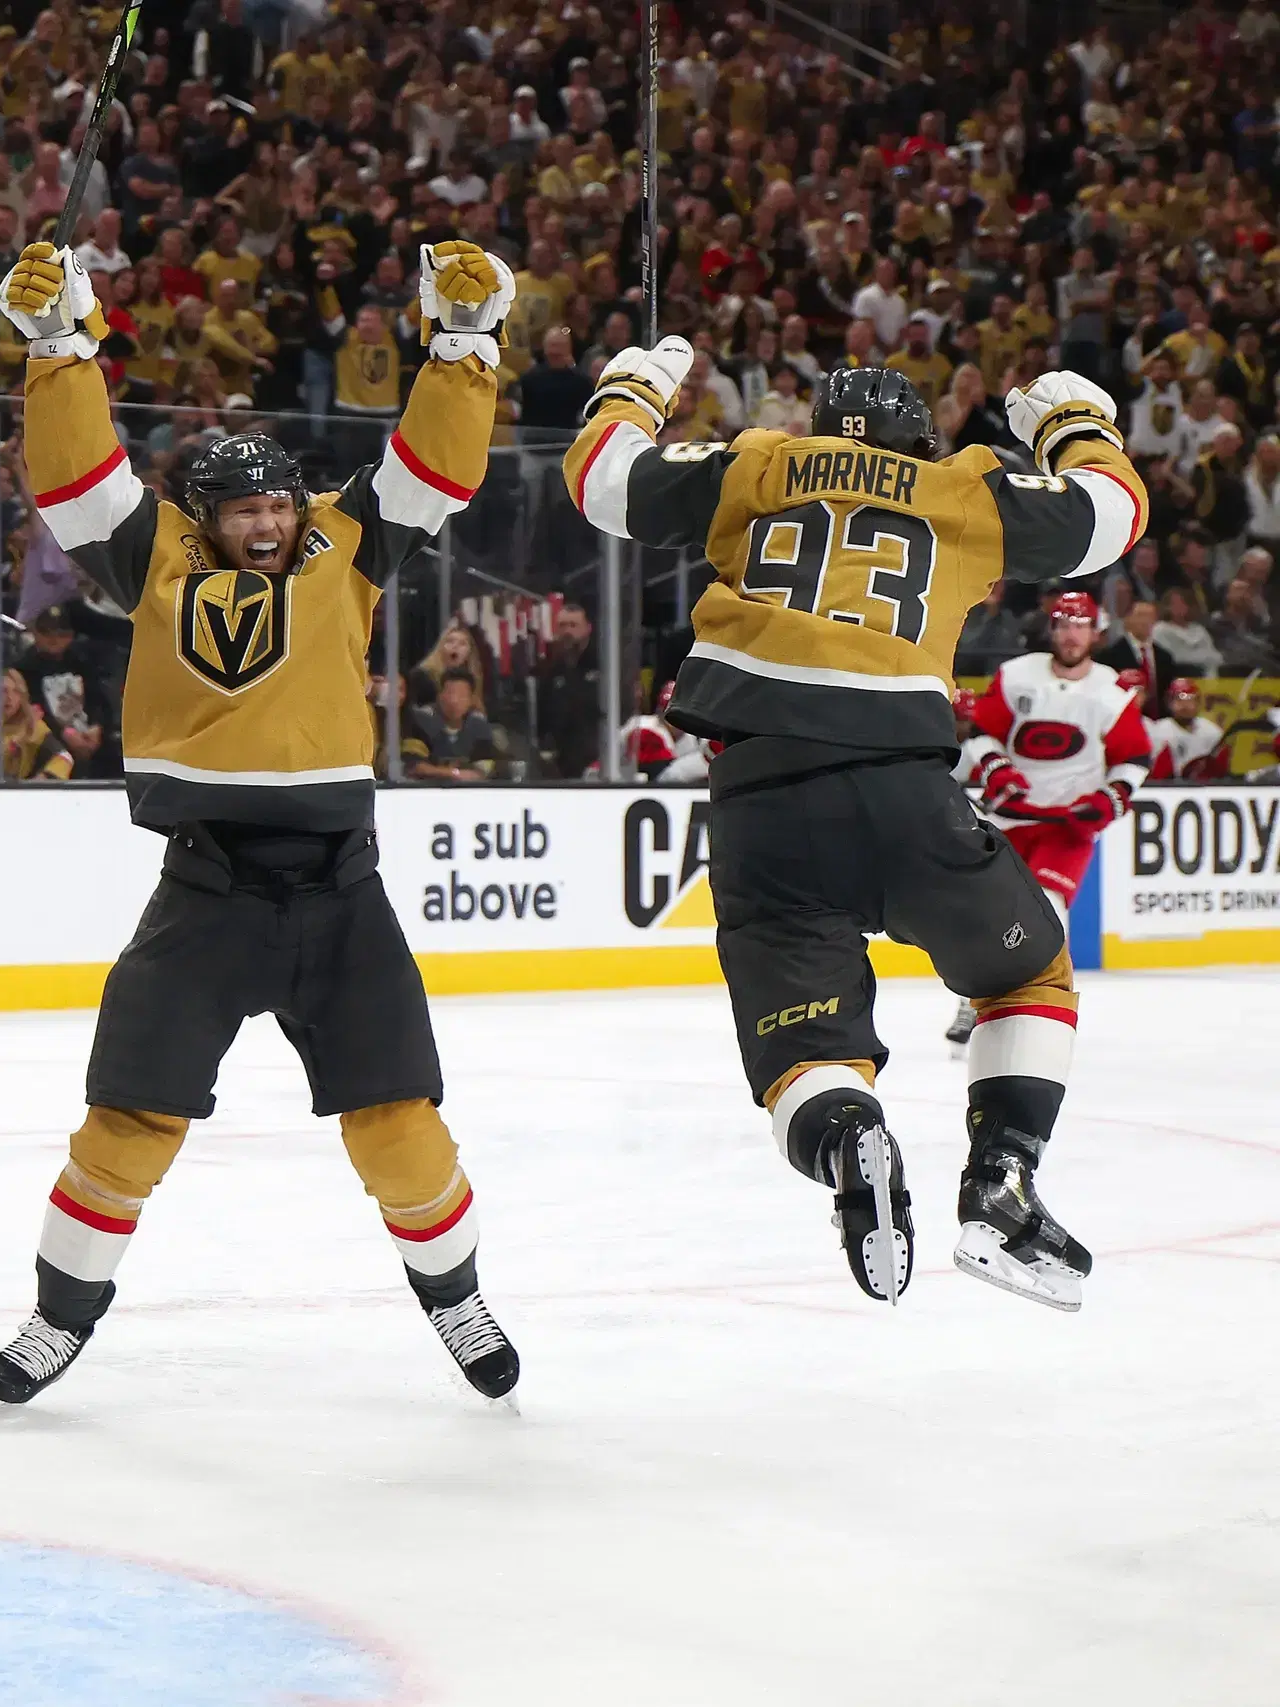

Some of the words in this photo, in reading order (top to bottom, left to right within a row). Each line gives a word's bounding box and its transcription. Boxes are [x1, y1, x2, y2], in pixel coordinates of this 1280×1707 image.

[236, 441, 260, 457] 71
[842, 415, 866, 437] 93
[785, 451, 919, 505] MARNER
[740, 499, 939, 646] 93
[431, 822, 453, 860] a
[473, 807, 548, 860] sub
[1131, 799, 1280, 876] BODY
[625, 799, 710, 928] CA
[422, 869, 558, 922] above
[1133, 890, 1214, 915] SPORTS
[756, 997, 840, 1037] CCM
